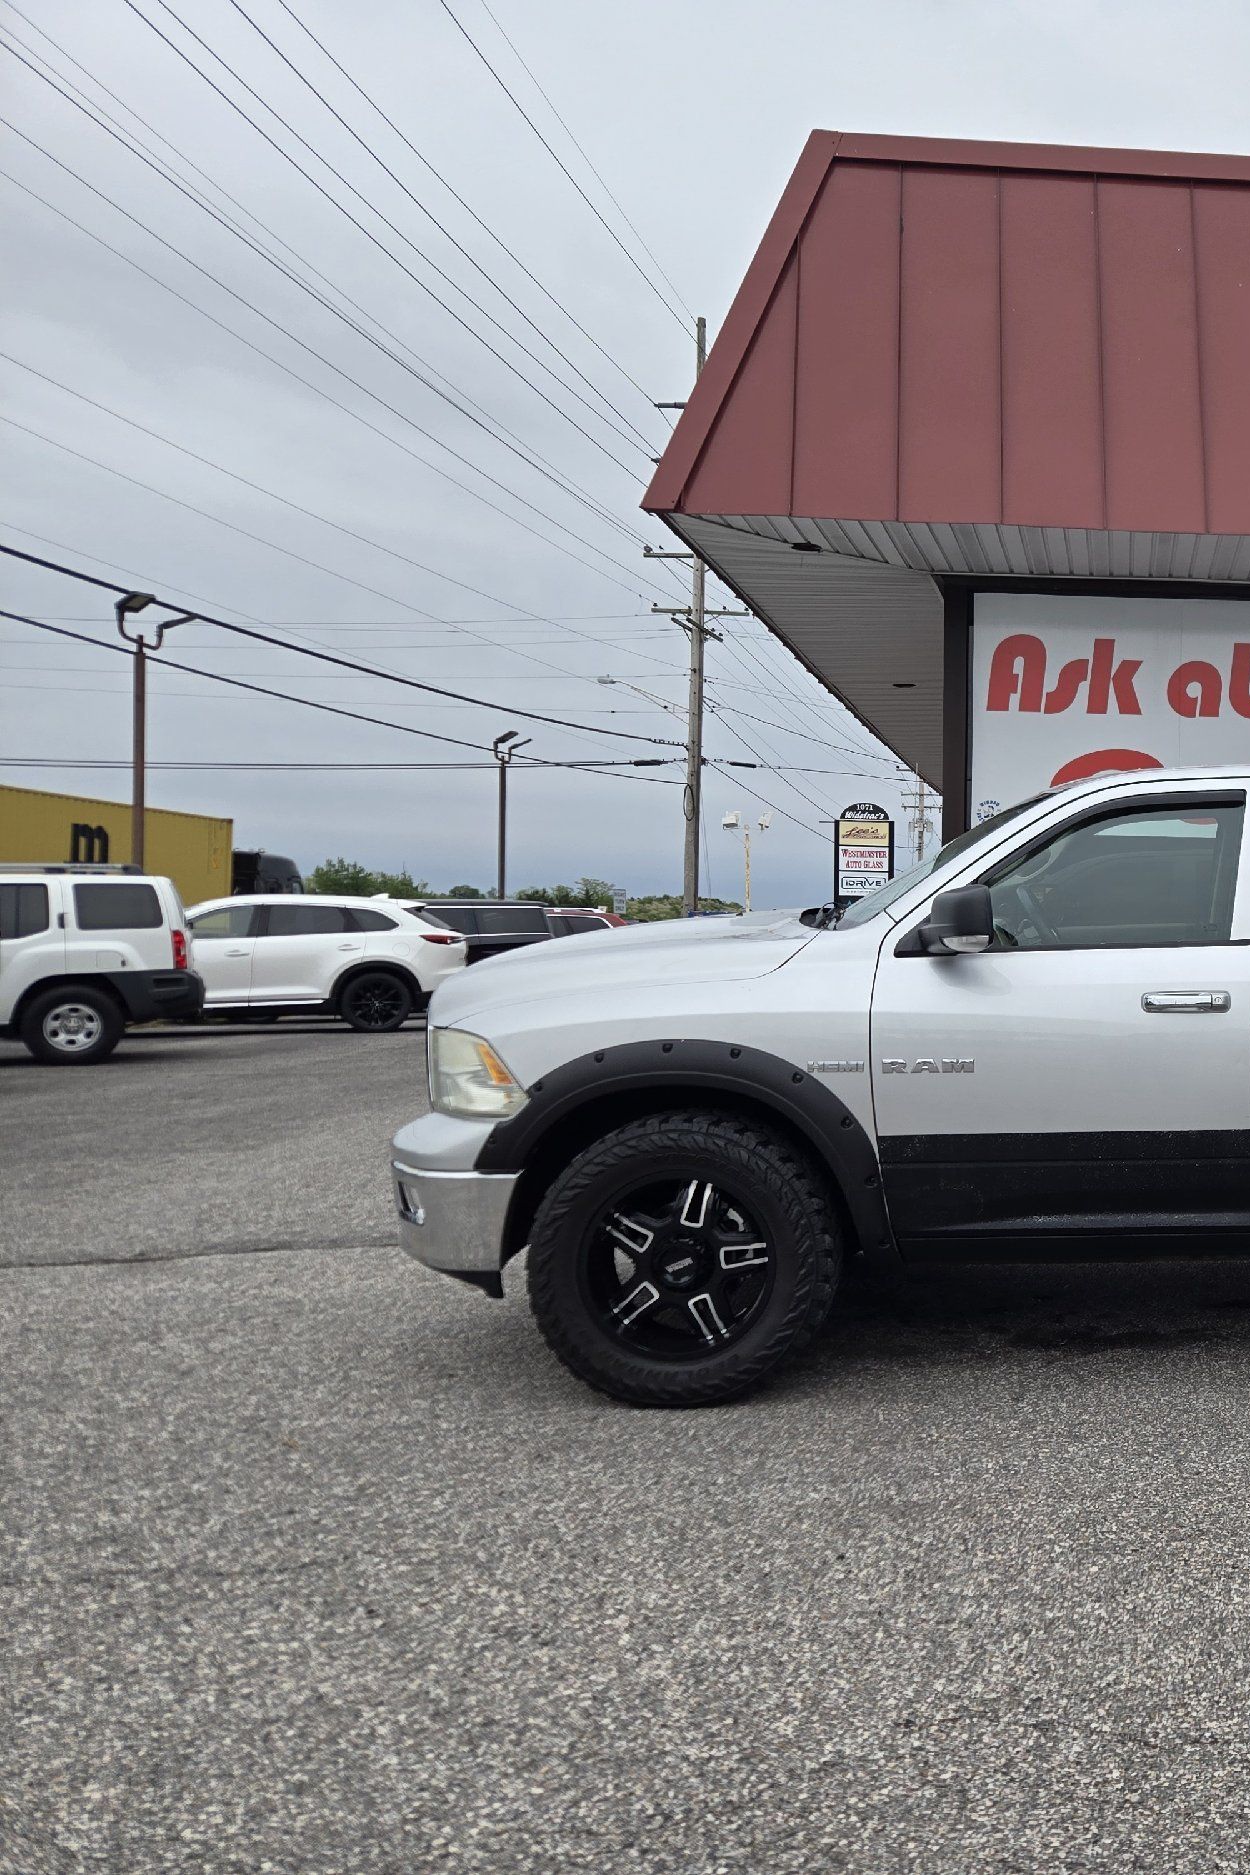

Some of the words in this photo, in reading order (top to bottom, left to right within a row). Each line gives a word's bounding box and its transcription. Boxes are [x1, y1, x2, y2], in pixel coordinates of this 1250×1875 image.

[986, 634, 1143, 716] Ask
[846, 860, 861, 868] AUTO
[864, 860, 884, 869] GLASS
[807, 1060, 865, 1073] HEMI
[882, 1058, 975, 1074] RAM
